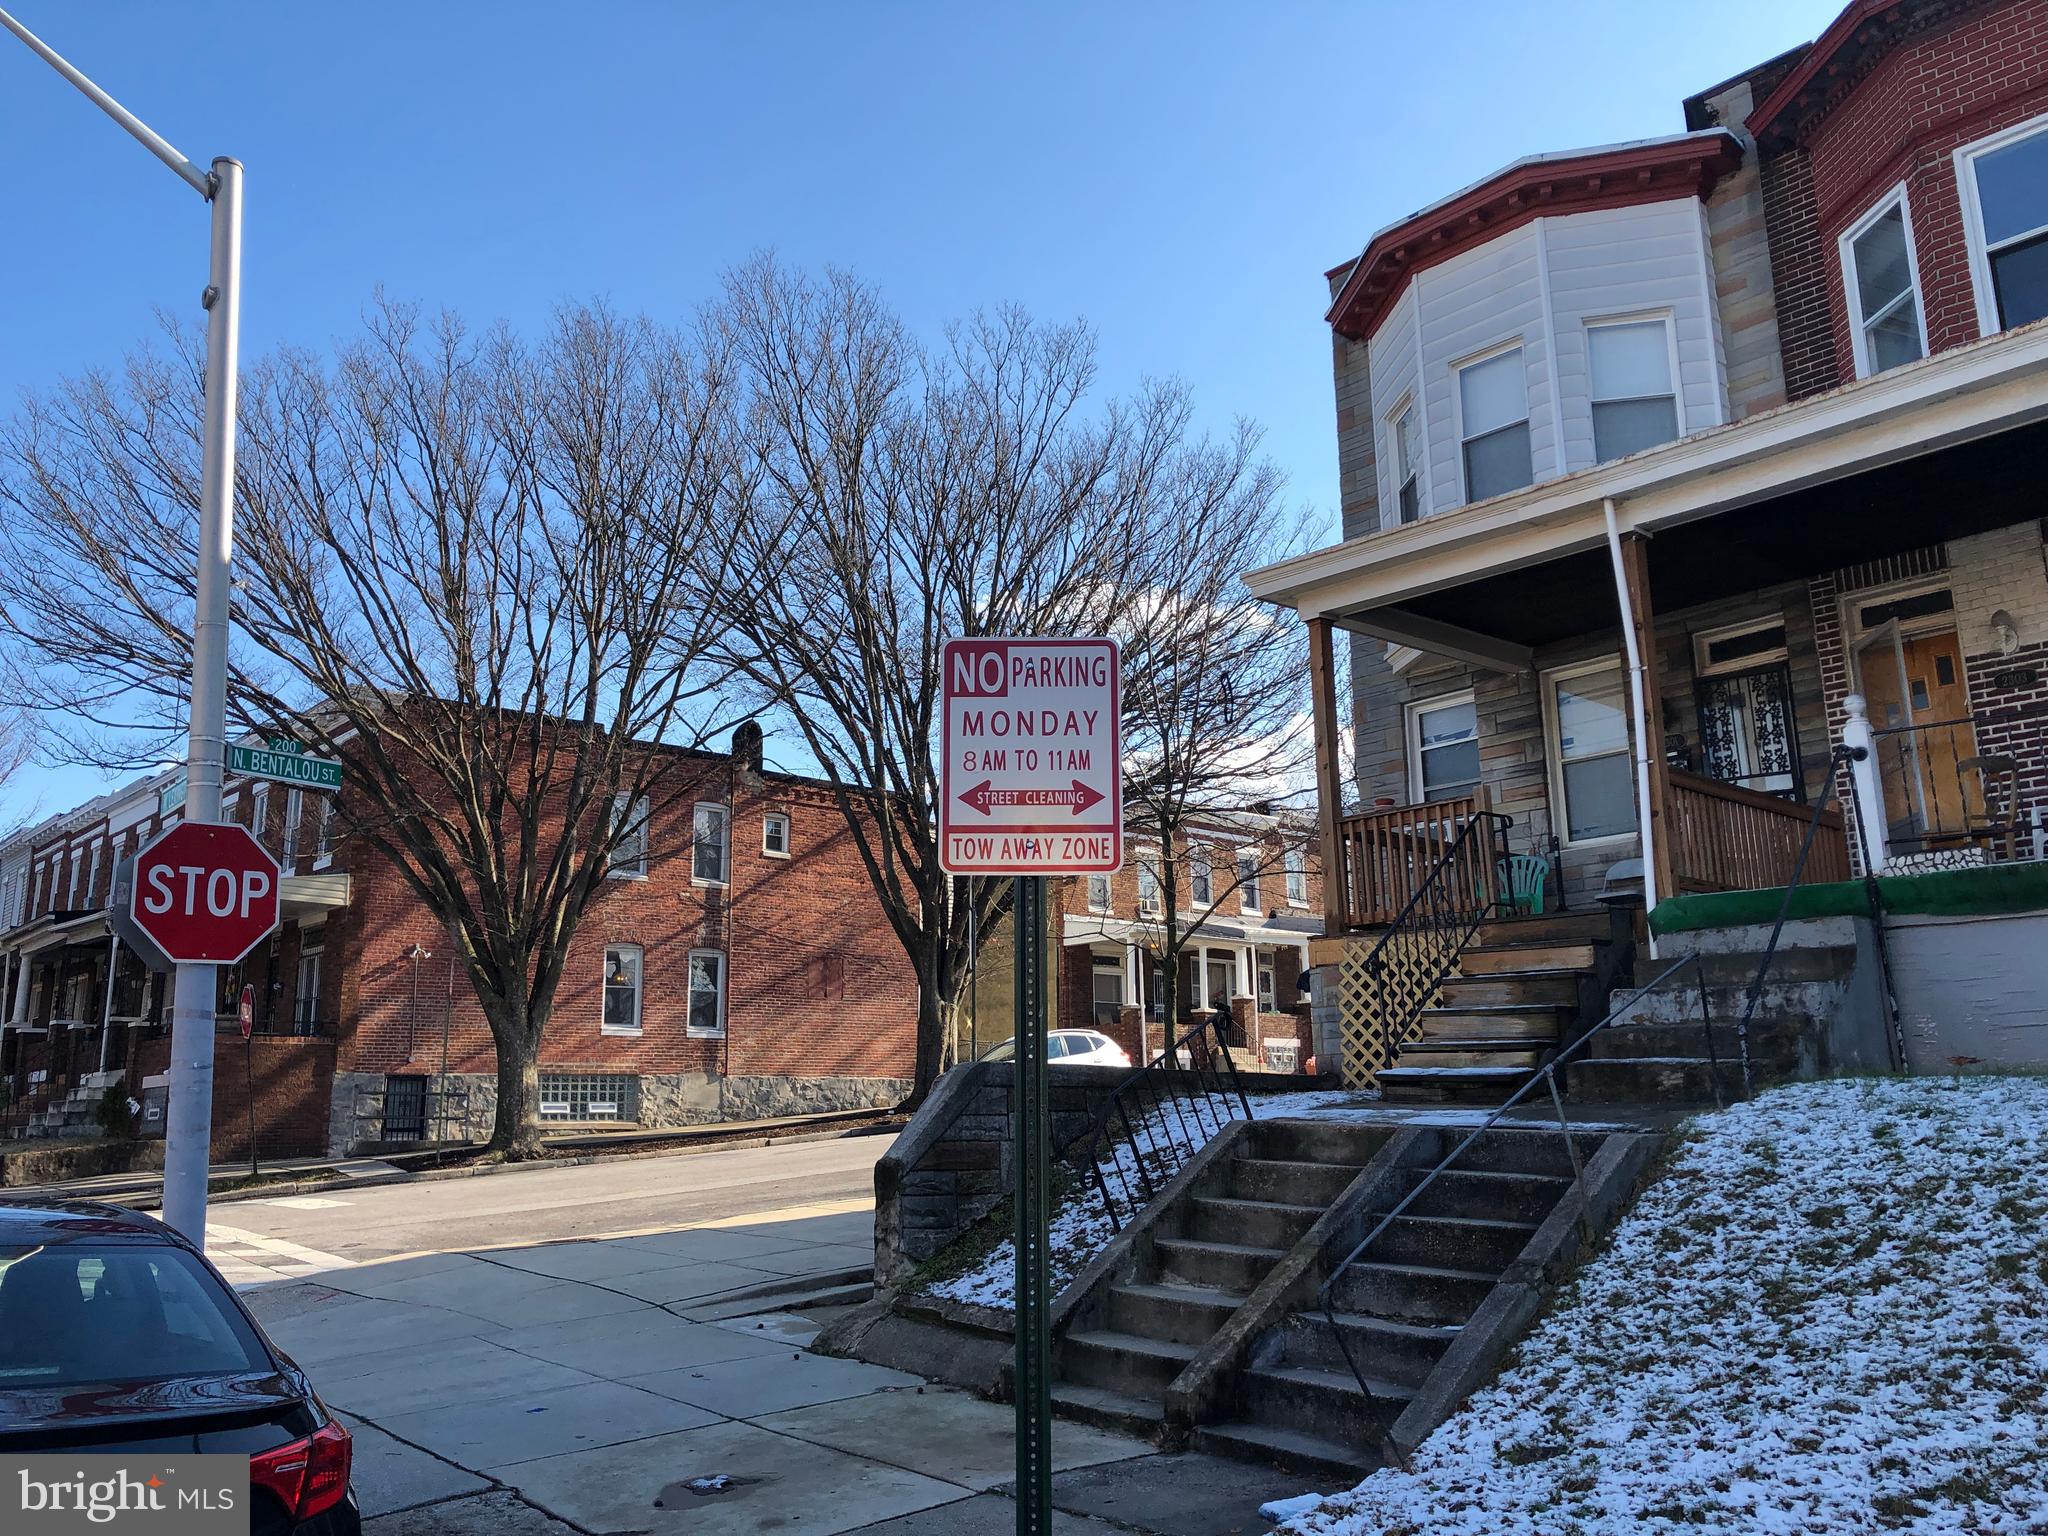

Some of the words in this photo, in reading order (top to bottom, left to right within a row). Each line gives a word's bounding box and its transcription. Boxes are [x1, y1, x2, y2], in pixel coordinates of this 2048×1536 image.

[953, 651, 1004, 694] NO
[1012, 656, 1106, 688] PARKING
[962, 710, 1099, 737] MONDAY
[274, 739, 297, 753] 200
[233, 749, 246, 769] N.
[250, 751, 320, 782] BENTALOU
[321, 768, 336, 782] ST.
[1015, 749, 1038, 771] TO
[977, 791, 1019, 805] STREET
[1025, 791, 1084, 805] CLEANING
[953, 838, 994, 860] TOW
[1001, 838, 1054, 860] AWAY
[1062, 837, 1110, 860] ZONE
[144, 864, 270, 918] STOP
